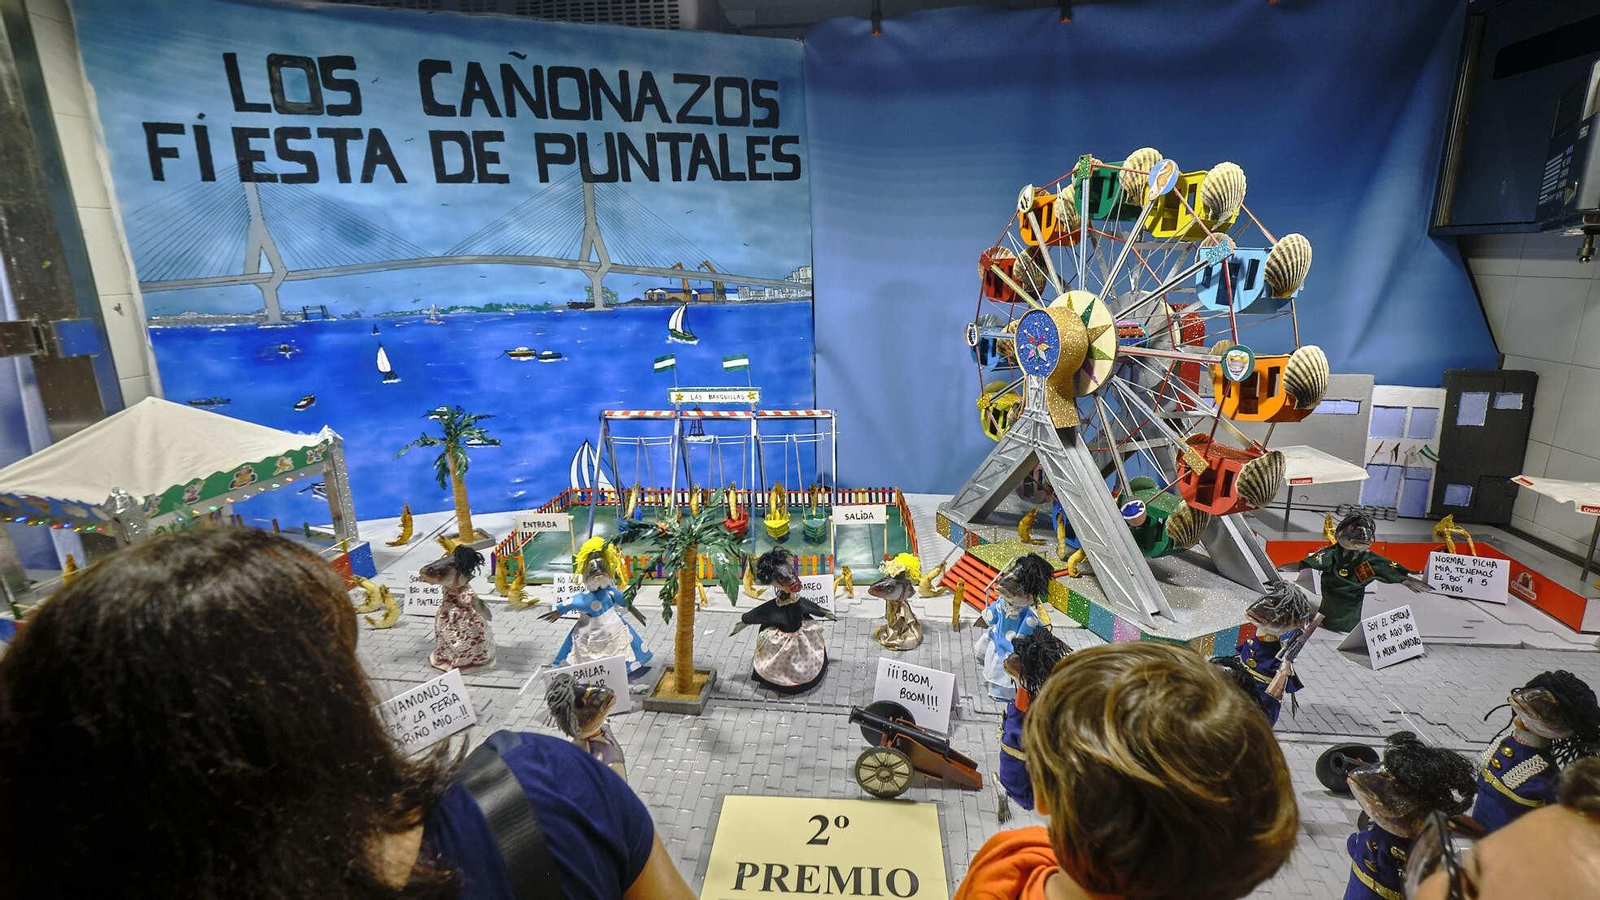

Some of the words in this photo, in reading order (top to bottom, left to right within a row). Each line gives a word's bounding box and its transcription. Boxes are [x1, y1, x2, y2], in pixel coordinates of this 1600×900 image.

[222, 52, 363, 116] LOS
[418, 51, 780, 129] CAÑONAZOS
[142, 112, 408, 185] FIESTA
[428, 130, 510, 184] DE
[534, 132, 801, 184] PUNTALES
[522, 521, 558, 529] ENTRADA
[844, 510, 875, 521] SALIDA
[1435, 555, 1466, 566] NORMAL
[1472, 558, 1498, 569] PICHA
[1455, 566, 1493, 578] TENEMOS
[803, 582, 822, 592] AREO
[1434, 573, 1444, 581] EL
[1440, 583, 1463, 593] PAVOS
[390, 679, 450, 716] VAMONOS
[900, 687, 939, 713] BOOM!!!
[413, 710, 426, 724] LA
[429, 693, 460, 714] FERIA
[806, 814, 850, 846] 2º
[730, 861, 920, 898] PREMIO
